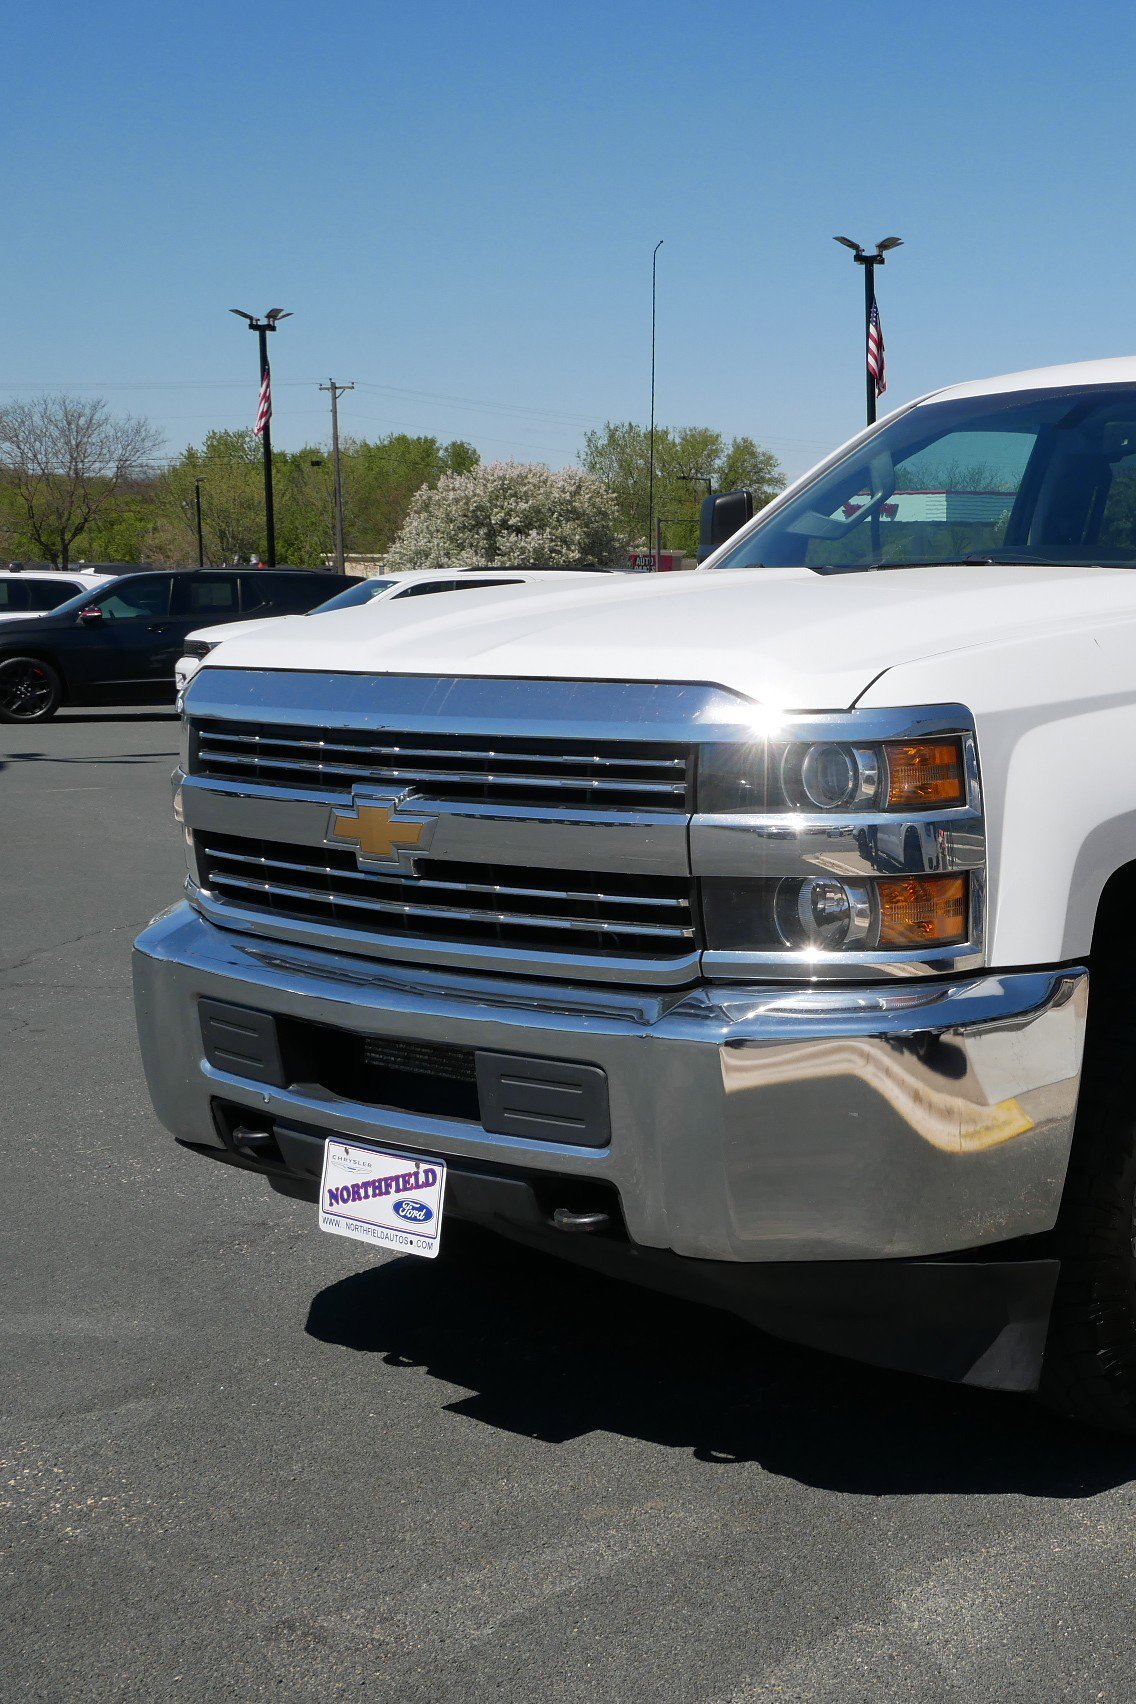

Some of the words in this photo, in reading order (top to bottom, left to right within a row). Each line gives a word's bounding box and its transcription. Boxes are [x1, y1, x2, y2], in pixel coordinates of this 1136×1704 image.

[331, 1154, 373, 1168] CHRYSLER
[327, 1167, 438, 1207] NORTHFIELD
[399, 1201, 426, 1220] Ford
